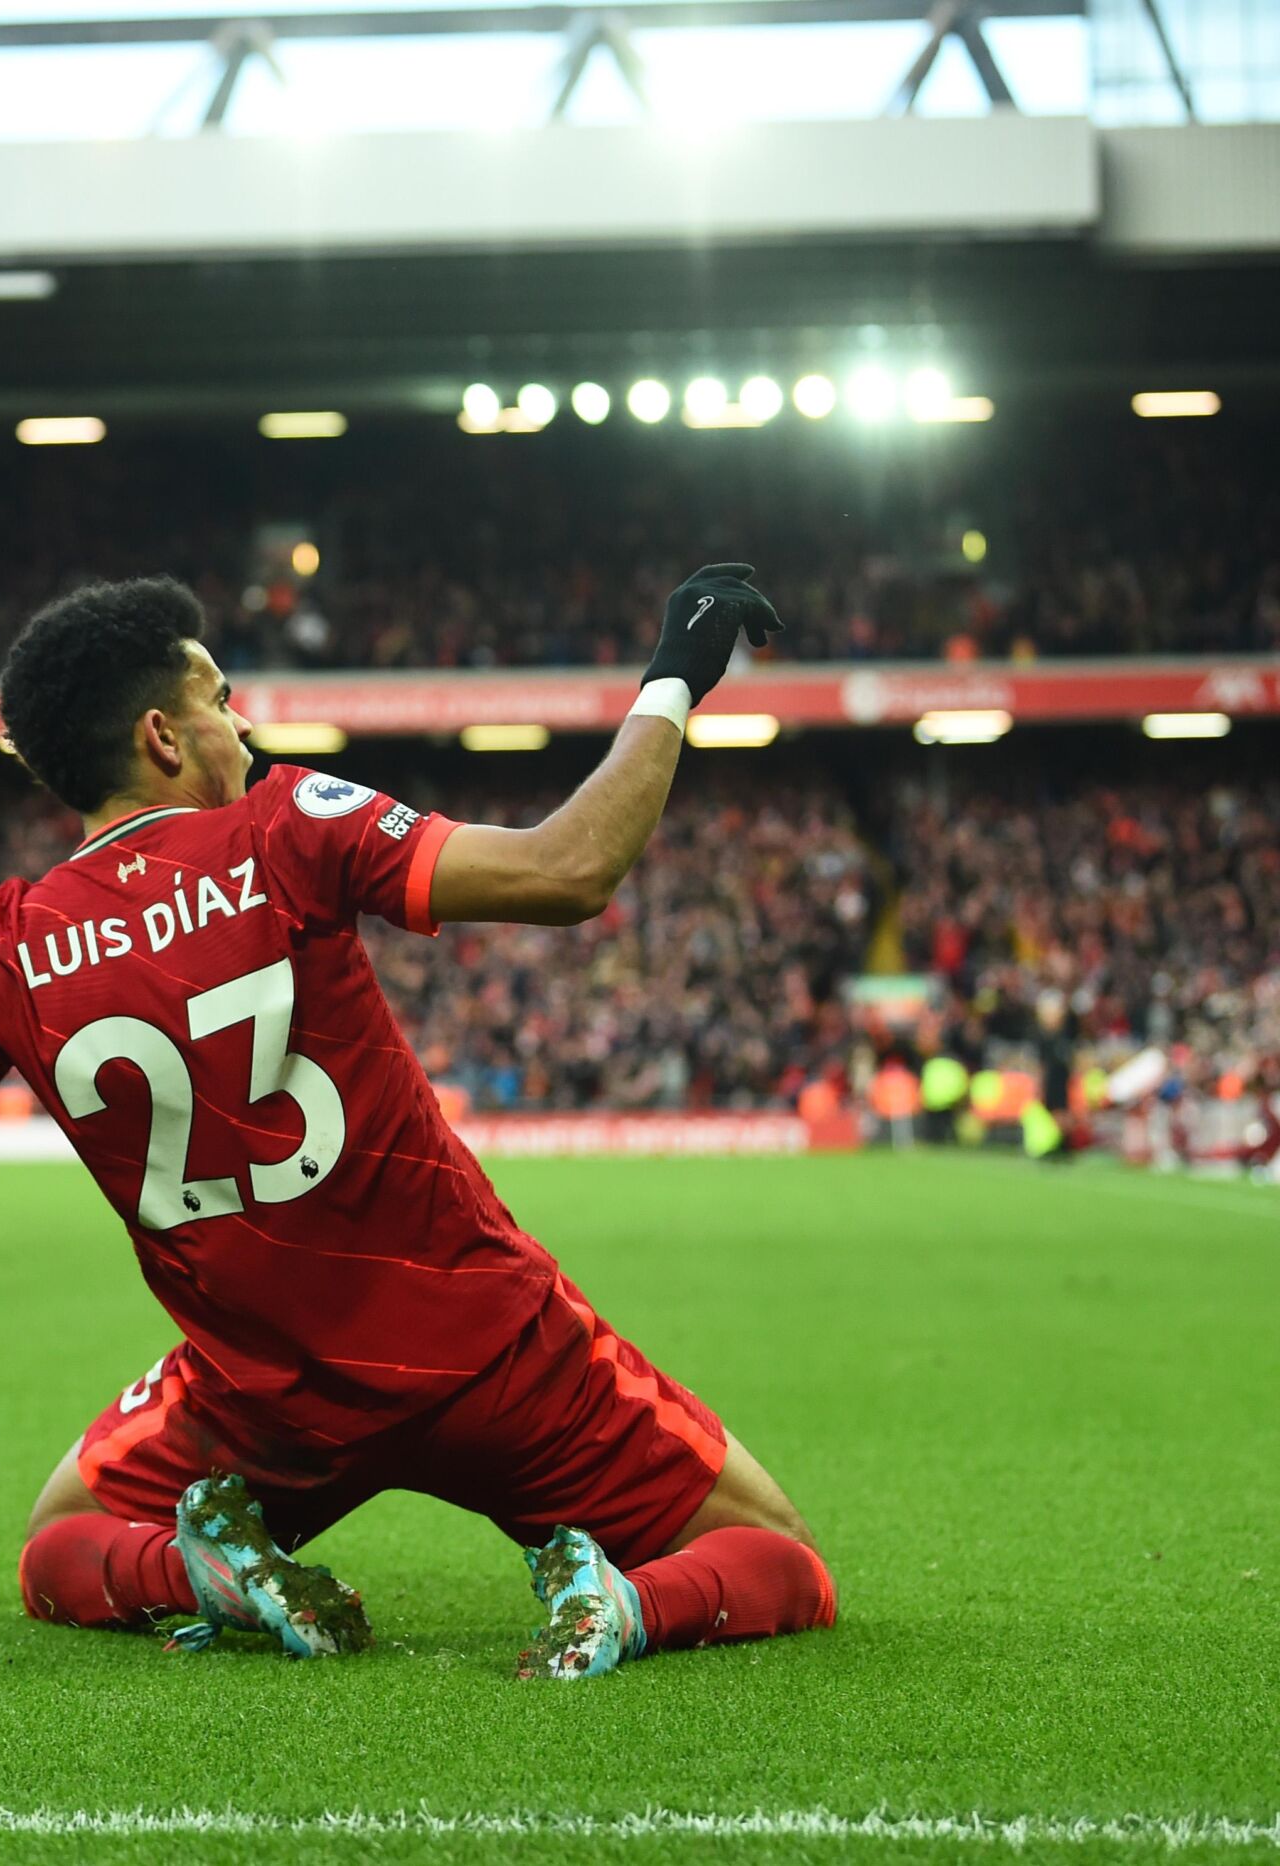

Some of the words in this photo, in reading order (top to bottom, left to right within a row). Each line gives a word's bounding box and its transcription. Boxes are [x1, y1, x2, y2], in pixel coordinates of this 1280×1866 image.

[17, 918, 132, 989] LUIS
[142, 857, 267, 952] DÍAZ
[54, 956, 346, 1231] 23
